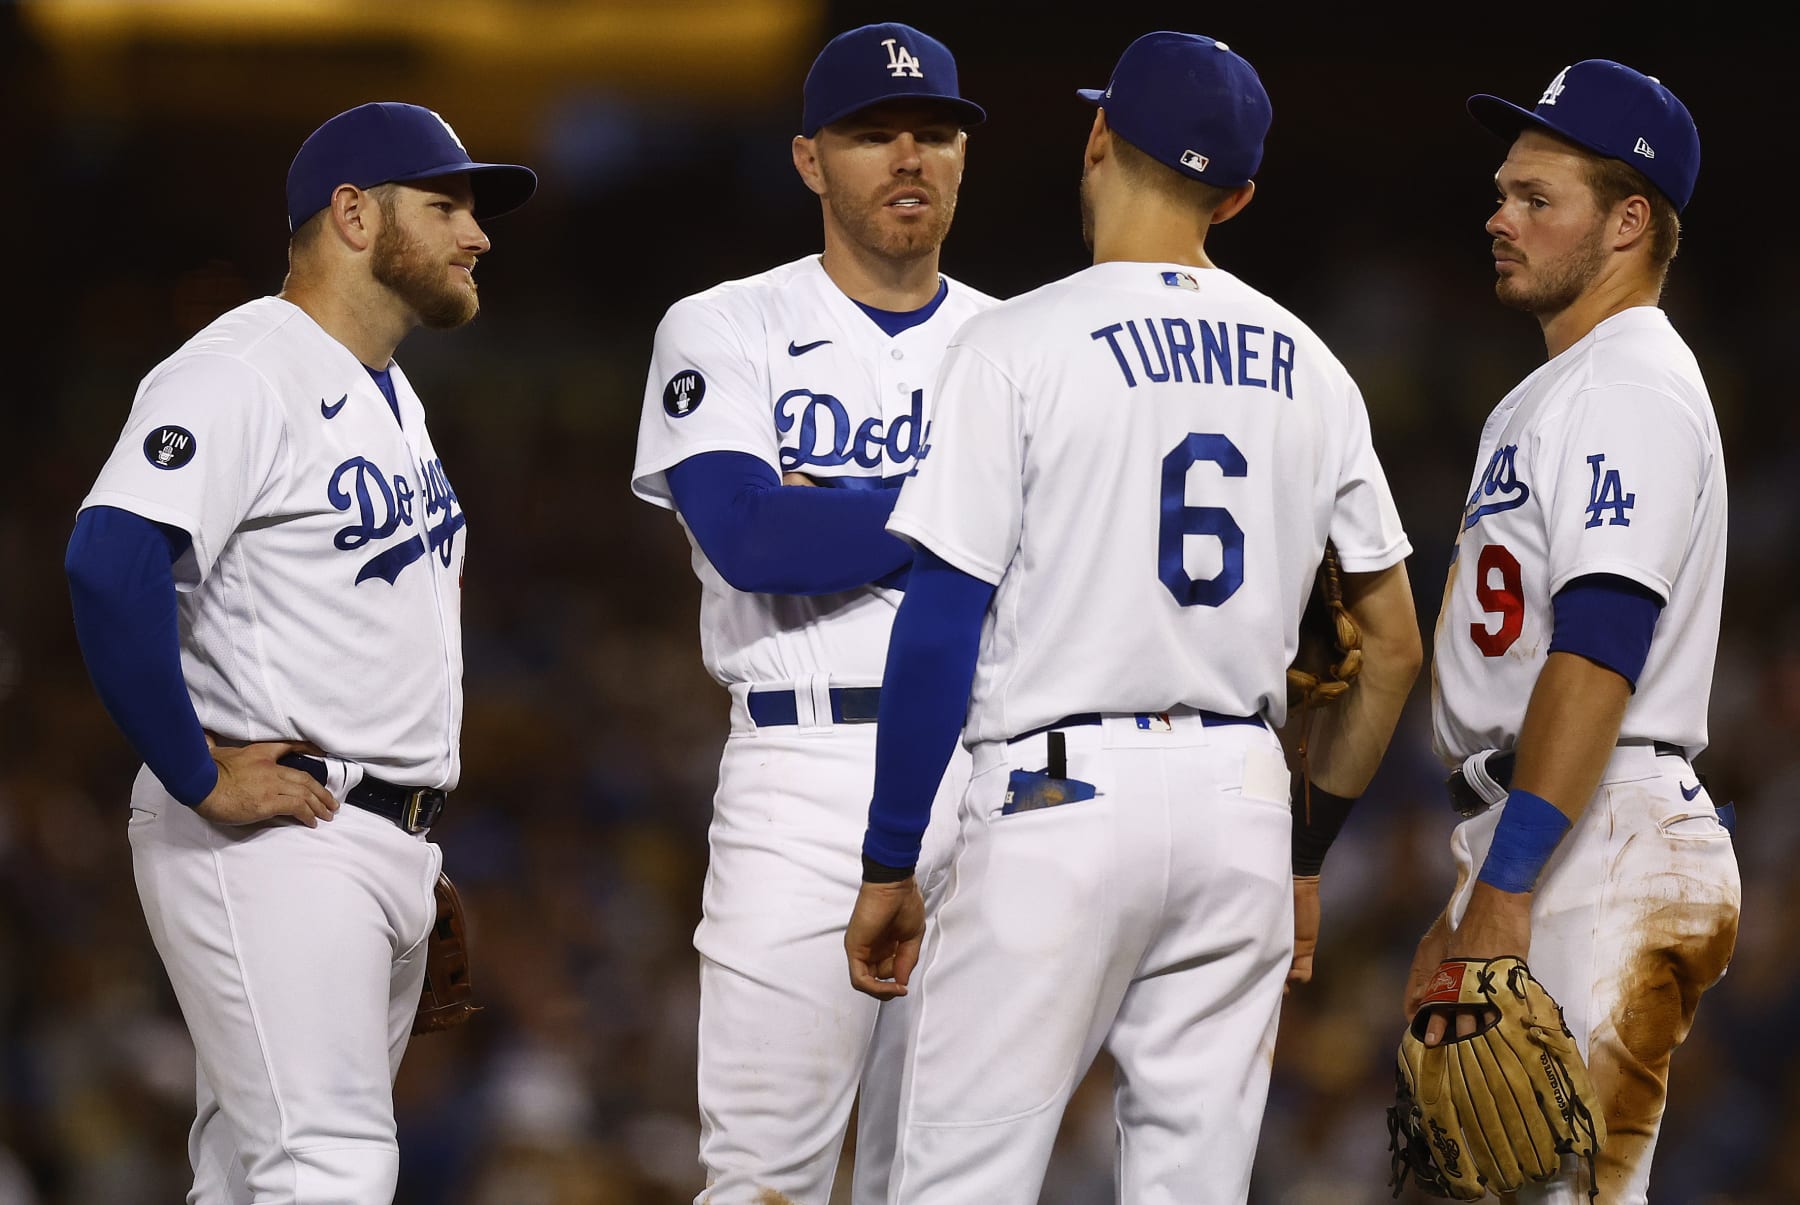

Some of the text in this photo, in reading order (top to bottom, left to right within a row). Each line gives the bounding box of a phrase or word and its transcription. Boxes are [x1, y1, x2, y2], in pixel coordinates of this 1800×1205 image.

[881, 39, 923, 78] LA
[672, 375, 695, 395] VIN
[1090, 318, 1295, 400] TURNER
[162, 430, 188, 450] VIN
[774, 389, 931, 471] Dod
[1158, 432, 1247, 607] 6
[1585, 454, 1635, 529] LA
[1470, 545, 1525, 657] 9
